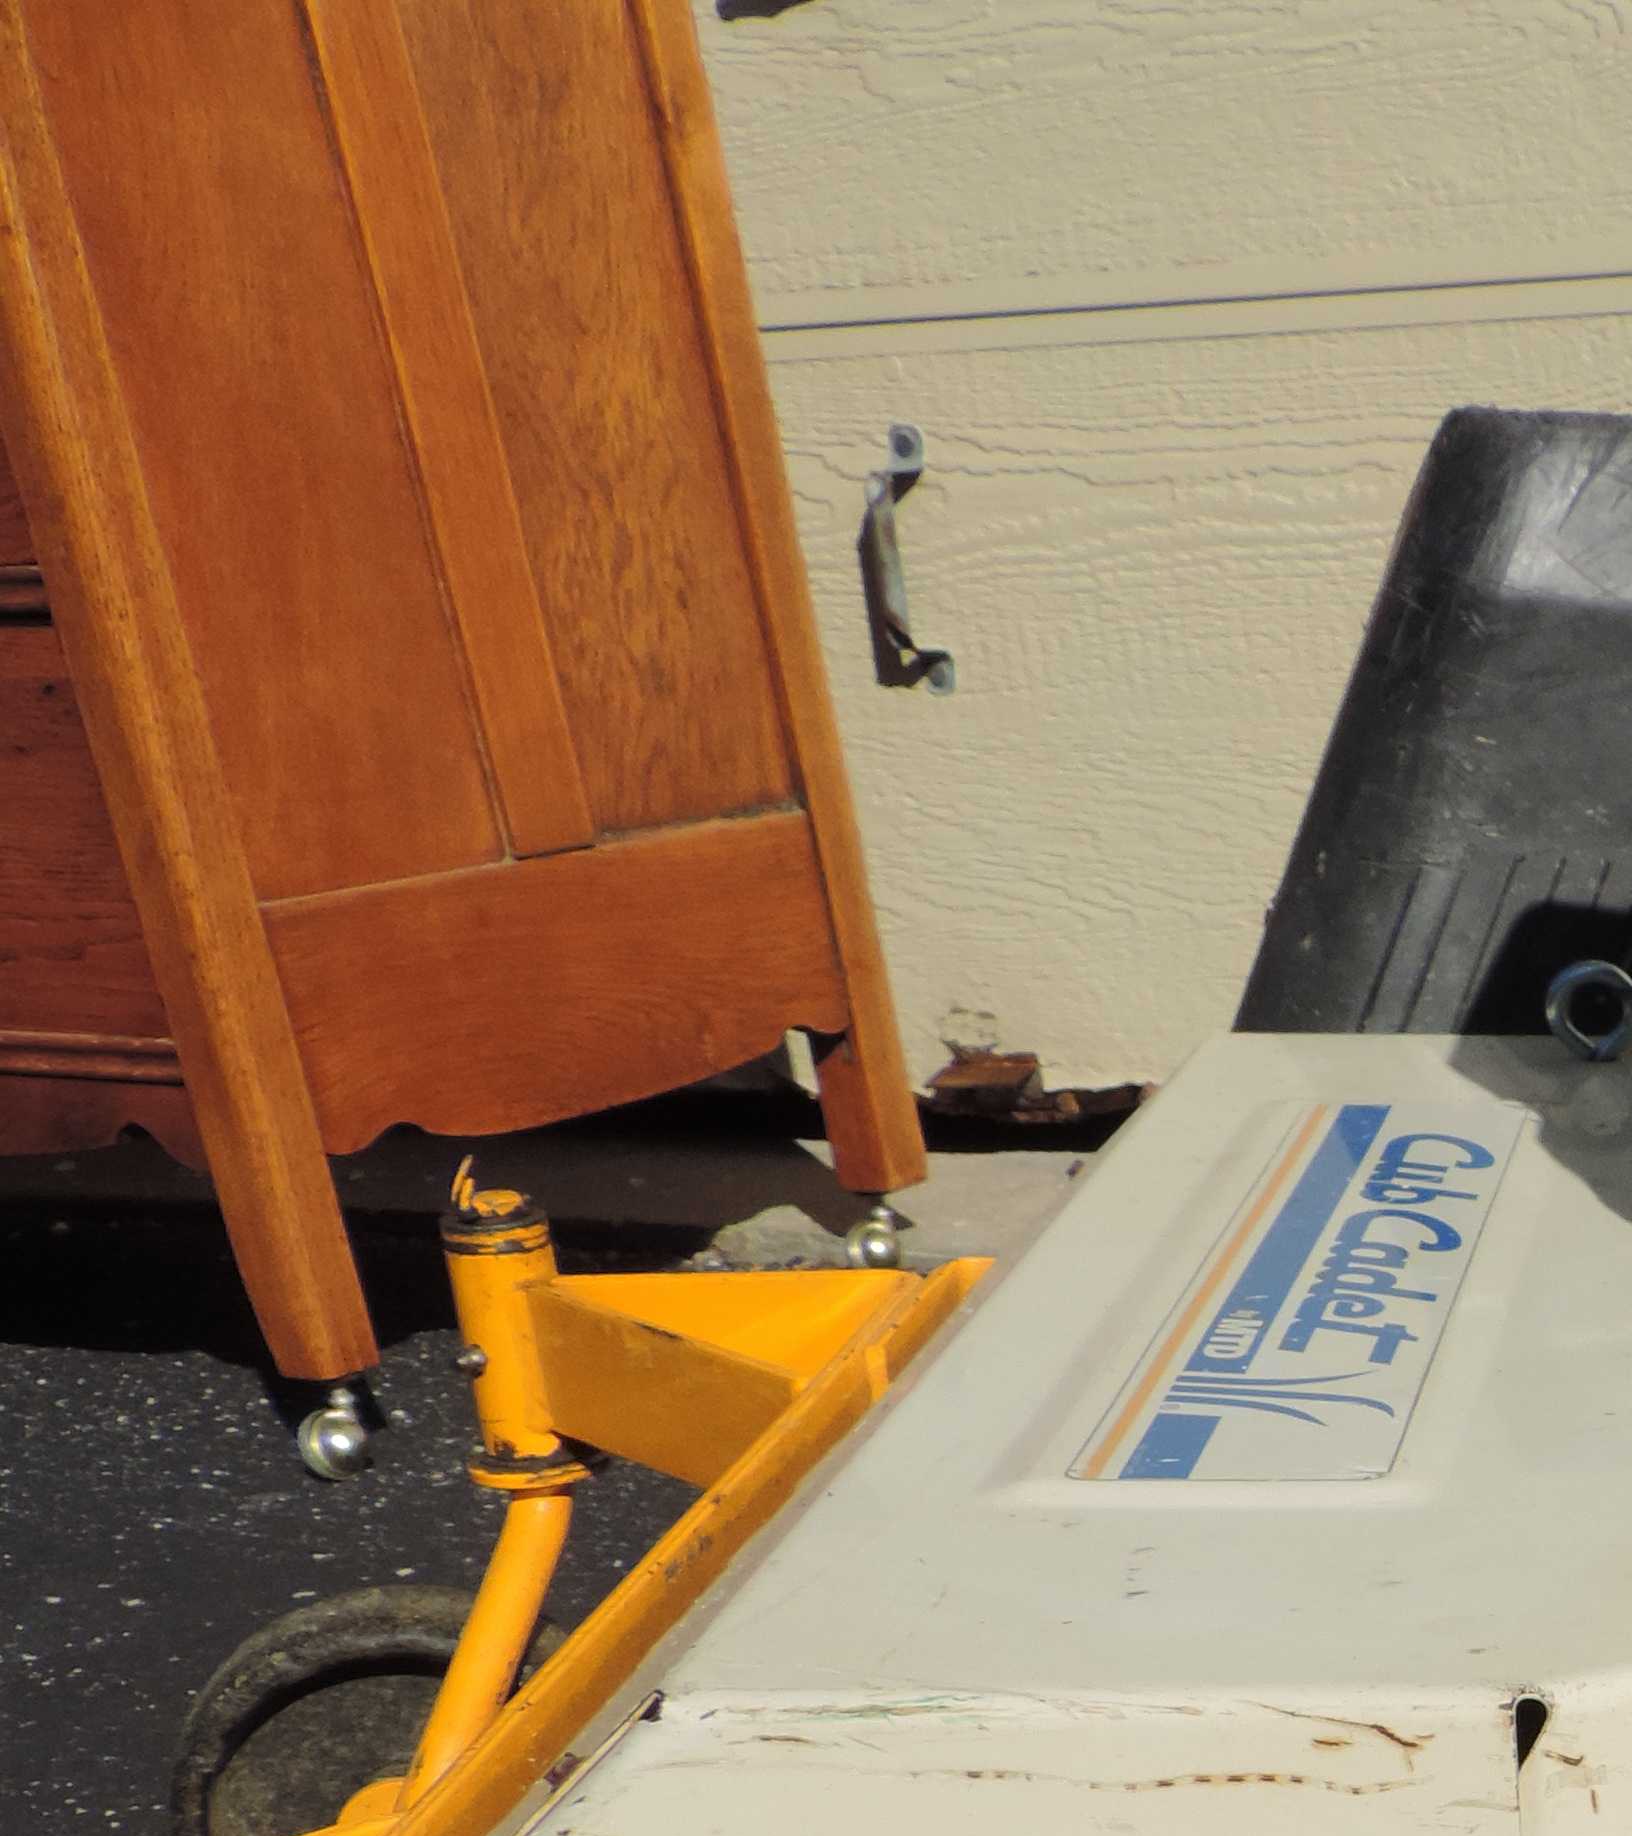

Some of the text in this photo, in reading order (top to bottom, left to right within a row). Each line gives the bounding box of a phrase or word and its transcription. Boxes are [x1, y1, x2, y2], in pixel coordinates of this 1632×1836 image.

[1278, 1133, 1496, 1366] Cub Cadet
[1203, 1318, 1264, 1359] MTD
